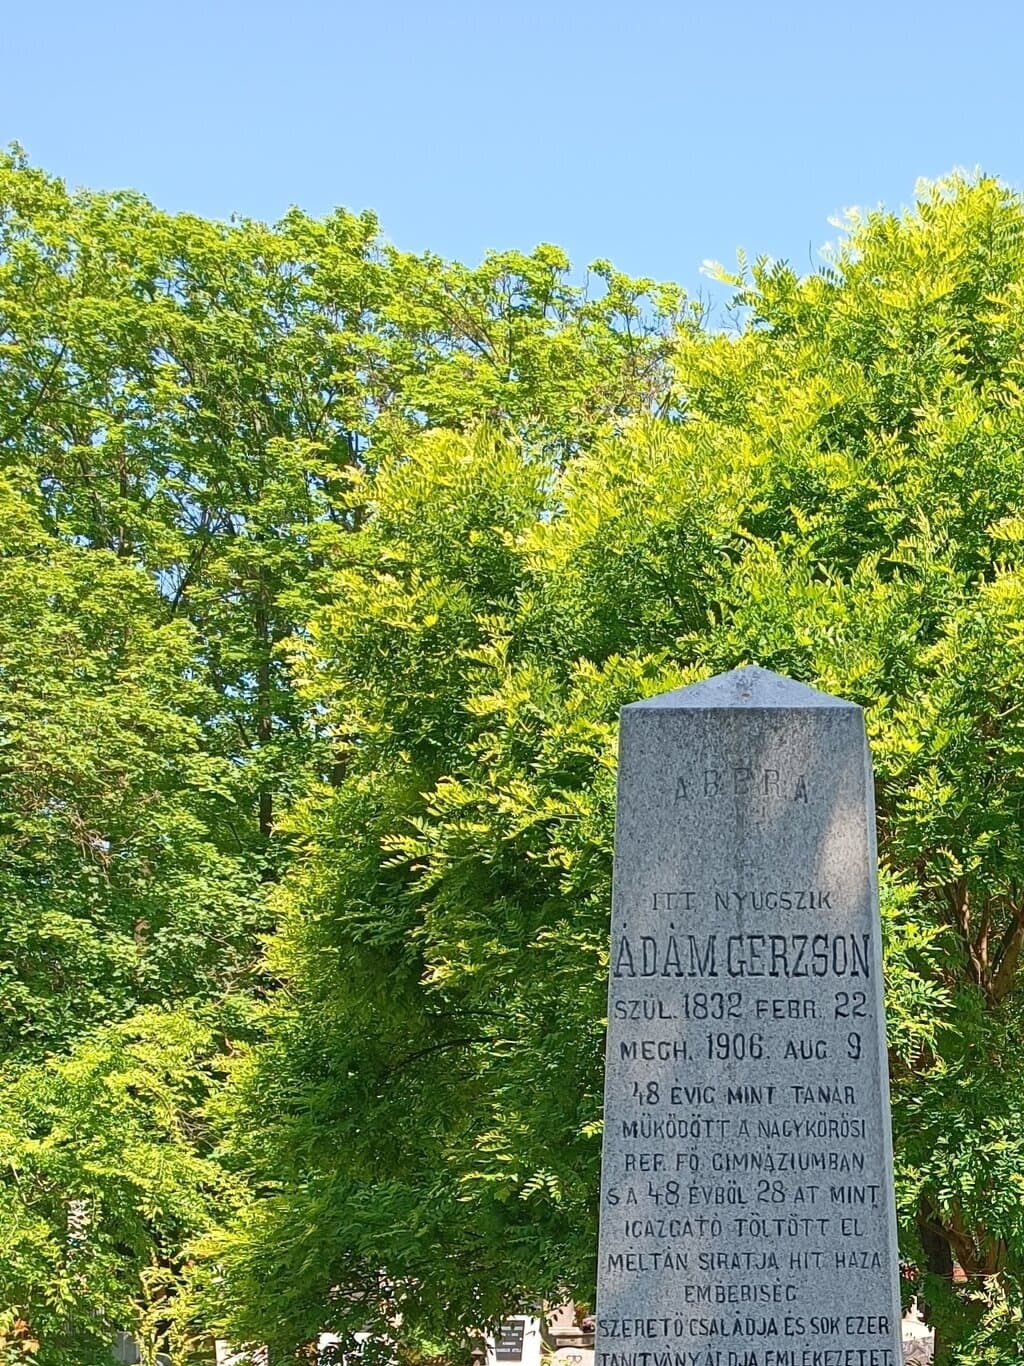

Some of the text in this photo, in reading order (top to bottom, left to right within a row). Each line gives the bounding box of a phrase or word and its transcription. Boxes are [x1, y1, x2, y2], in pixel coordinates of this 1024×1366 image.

[652, 891, 833, 910] ITT NYUGSZIK
[613, 923, 871, 978] ÁDÁM GERZSON
[614, 993, 678, 1020] SZÜL.
[684, 991, 743, 1020] 1832
[632, 1078, 856, 1106] 48 ÉVIG MINT TANÁR
[737, 1119, 750, 1138] A
[625, 1153, 667, 1172] REF.
[712, 1145, 865, 1173] GIMNÁZIUMBAN
[606, 1187, 620, 1206] S
[626, 1187, 638, 1205] A
[647, 1180, 681, 1206] 48
[757, 1179, 786, 1204] 28
[830, 1185, 880, 1204] MINT
[608, 1245, 688, 1272] MÉLTÁN
[698, 1252, 779, 1271] SIRATJA
[835, 1251, 882, 1270] HAZA
[689, 1310, 778, 1337] CSALÁDJA
[784, 1309, 806, 1337] ÉS
[810, 1316, 841, 1336] SOK
[846, 1315, 890, 1336] EZER
